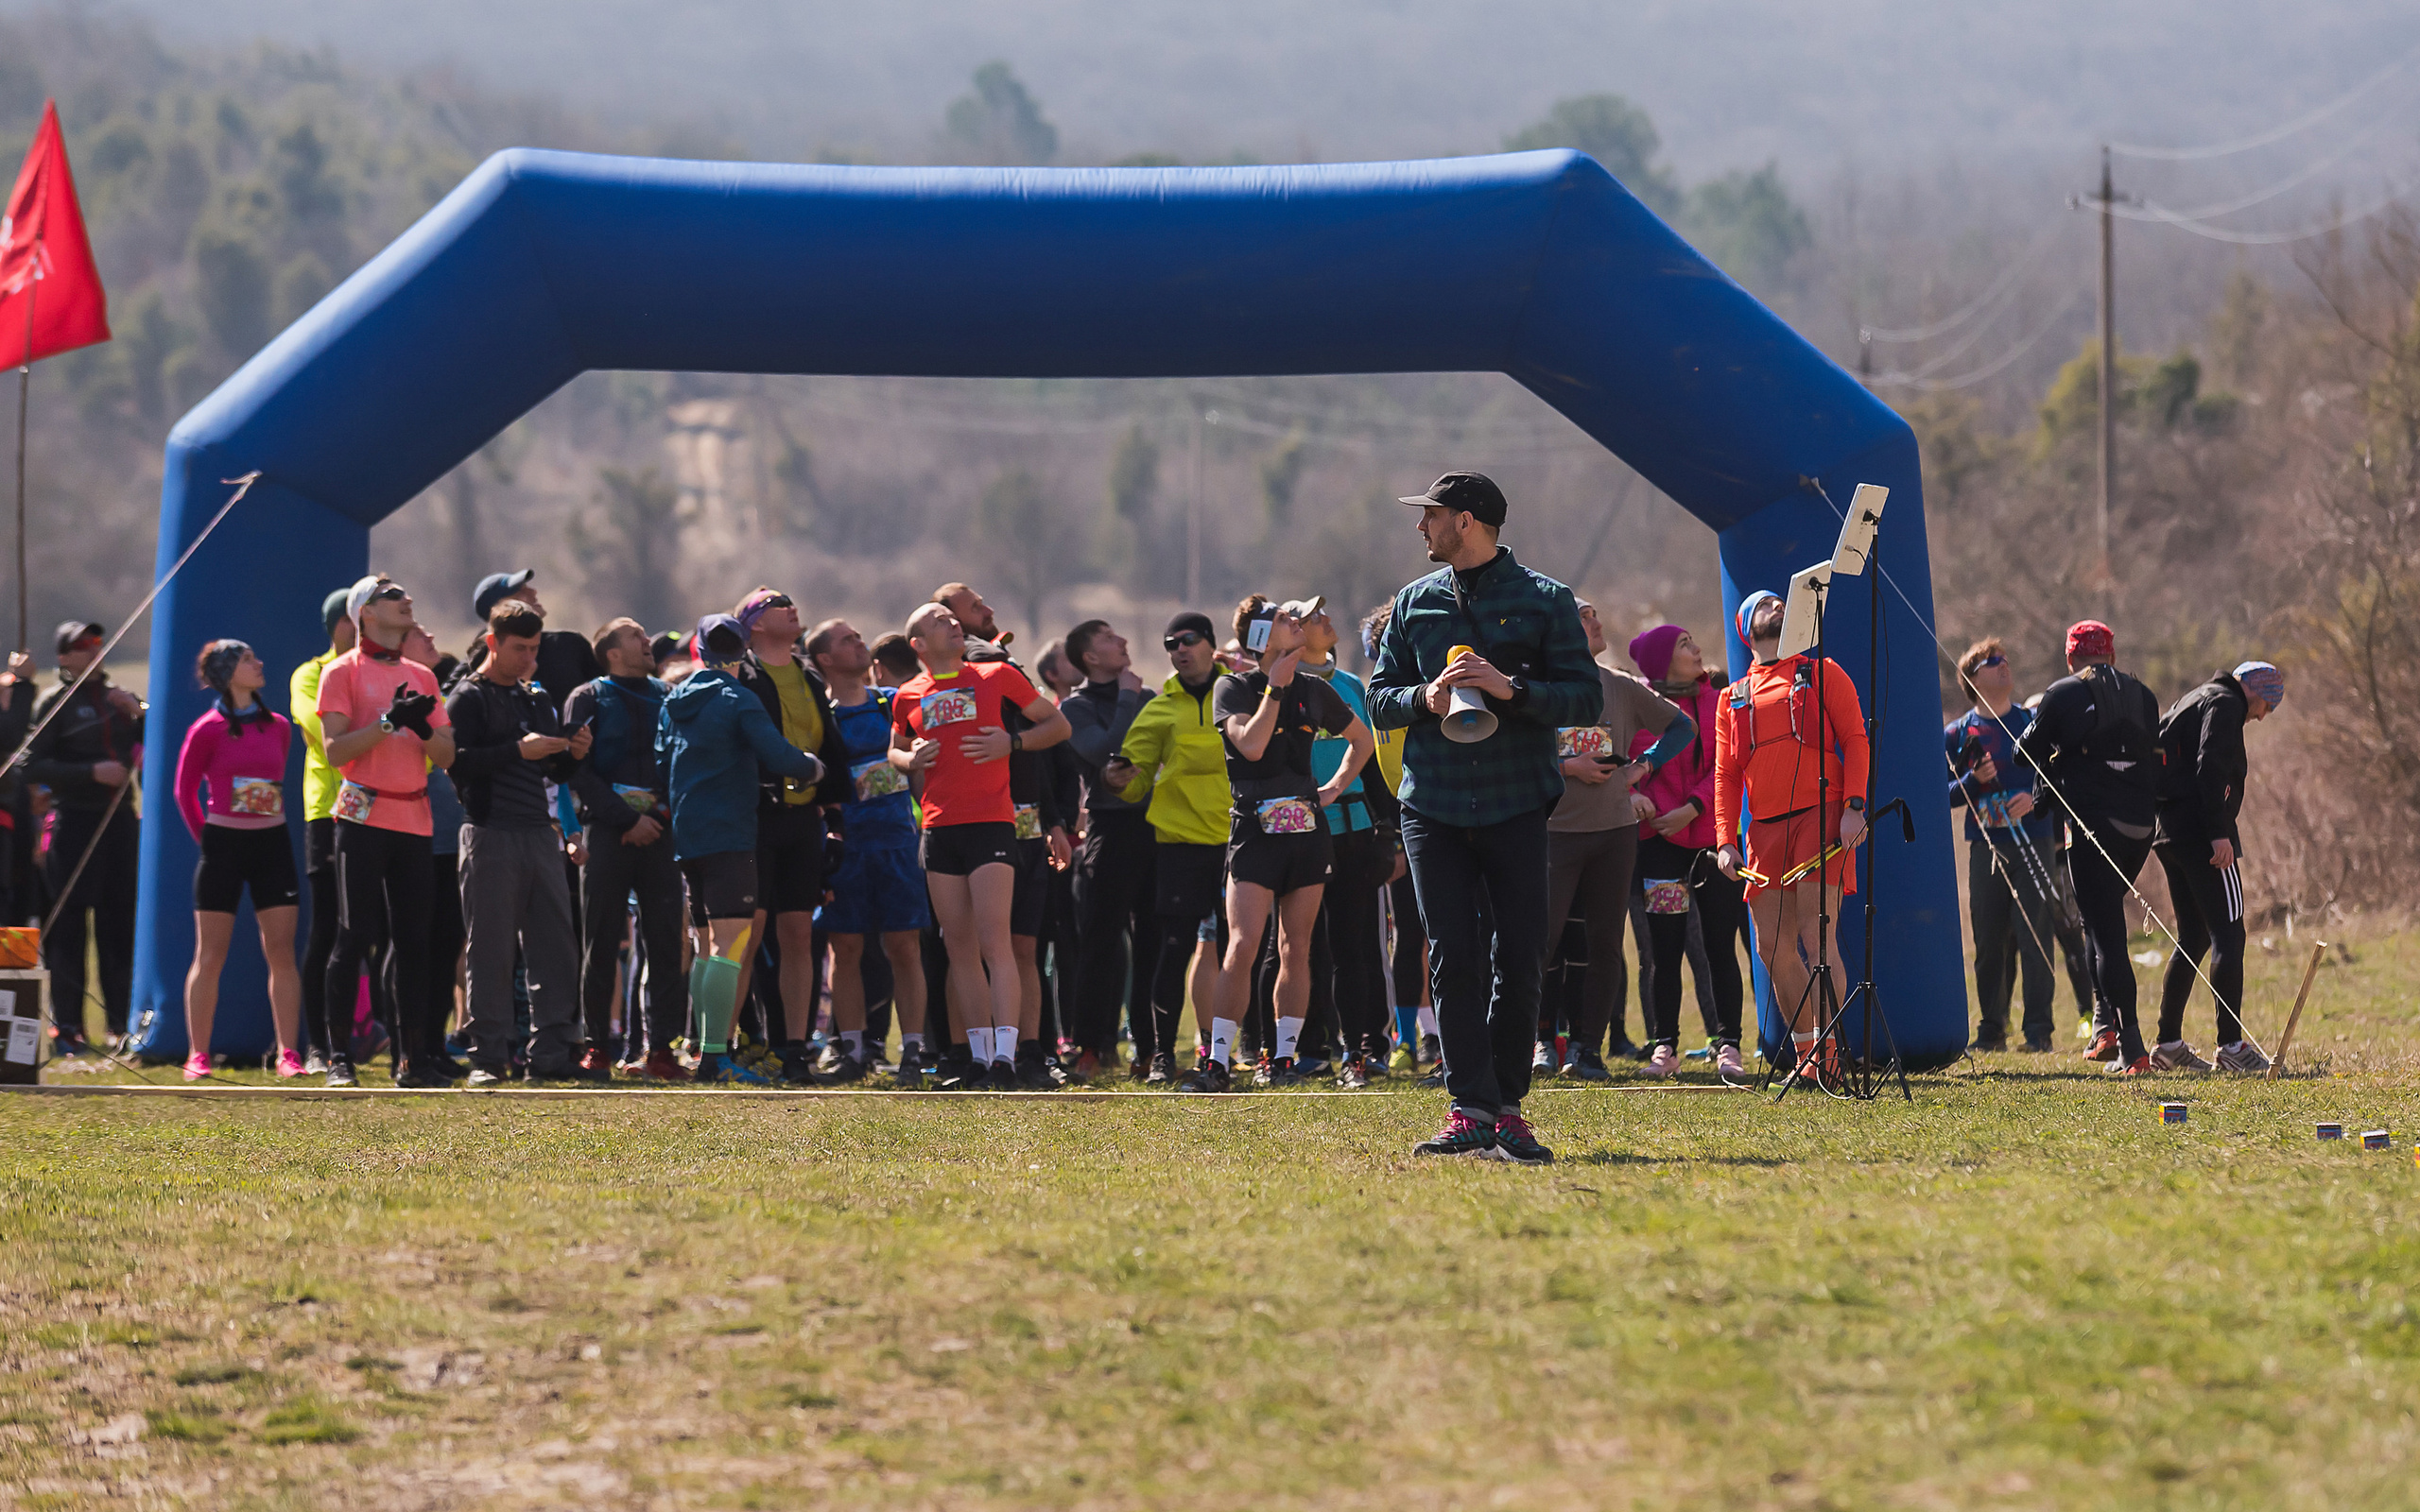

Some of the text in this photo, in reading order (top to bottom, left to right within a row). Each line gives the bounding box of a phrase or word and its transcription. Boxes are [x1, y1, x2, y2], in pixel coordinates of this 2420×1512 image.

[933, 698, 963, 723] 105
[1571, 730, 1600, 753] 169
[1271, 807, 1305, 831] 228
